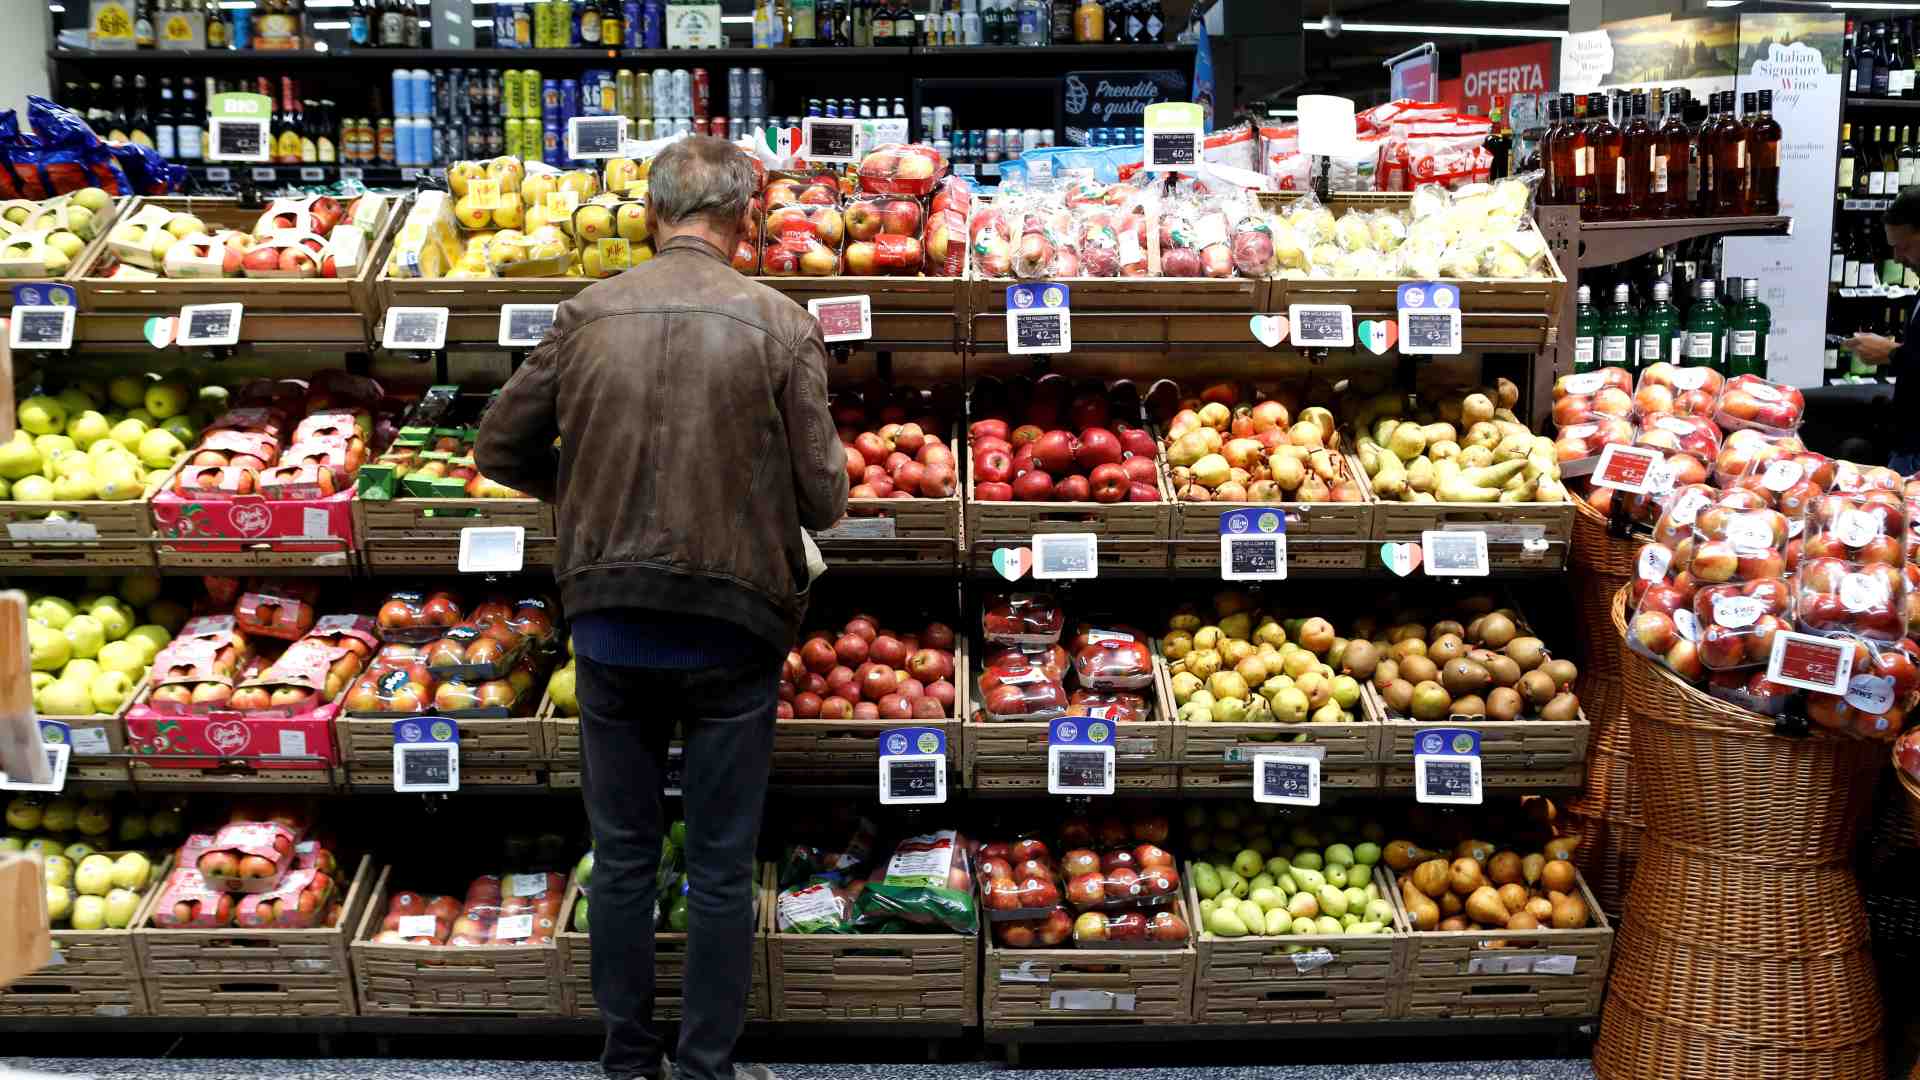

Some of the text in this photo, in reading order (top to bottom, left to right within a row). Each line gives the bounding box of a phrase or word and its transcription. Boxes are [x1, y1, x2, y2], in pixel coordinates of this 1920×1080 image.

[1775, 49, 1815, 63] Italian
[1759, 63, 1821, 79] Signature
[1464, 64, 1543, 97] OFFERTA
[1781, 78, 1819, 90] Wines
[1092, 103, 1101, 114] e
